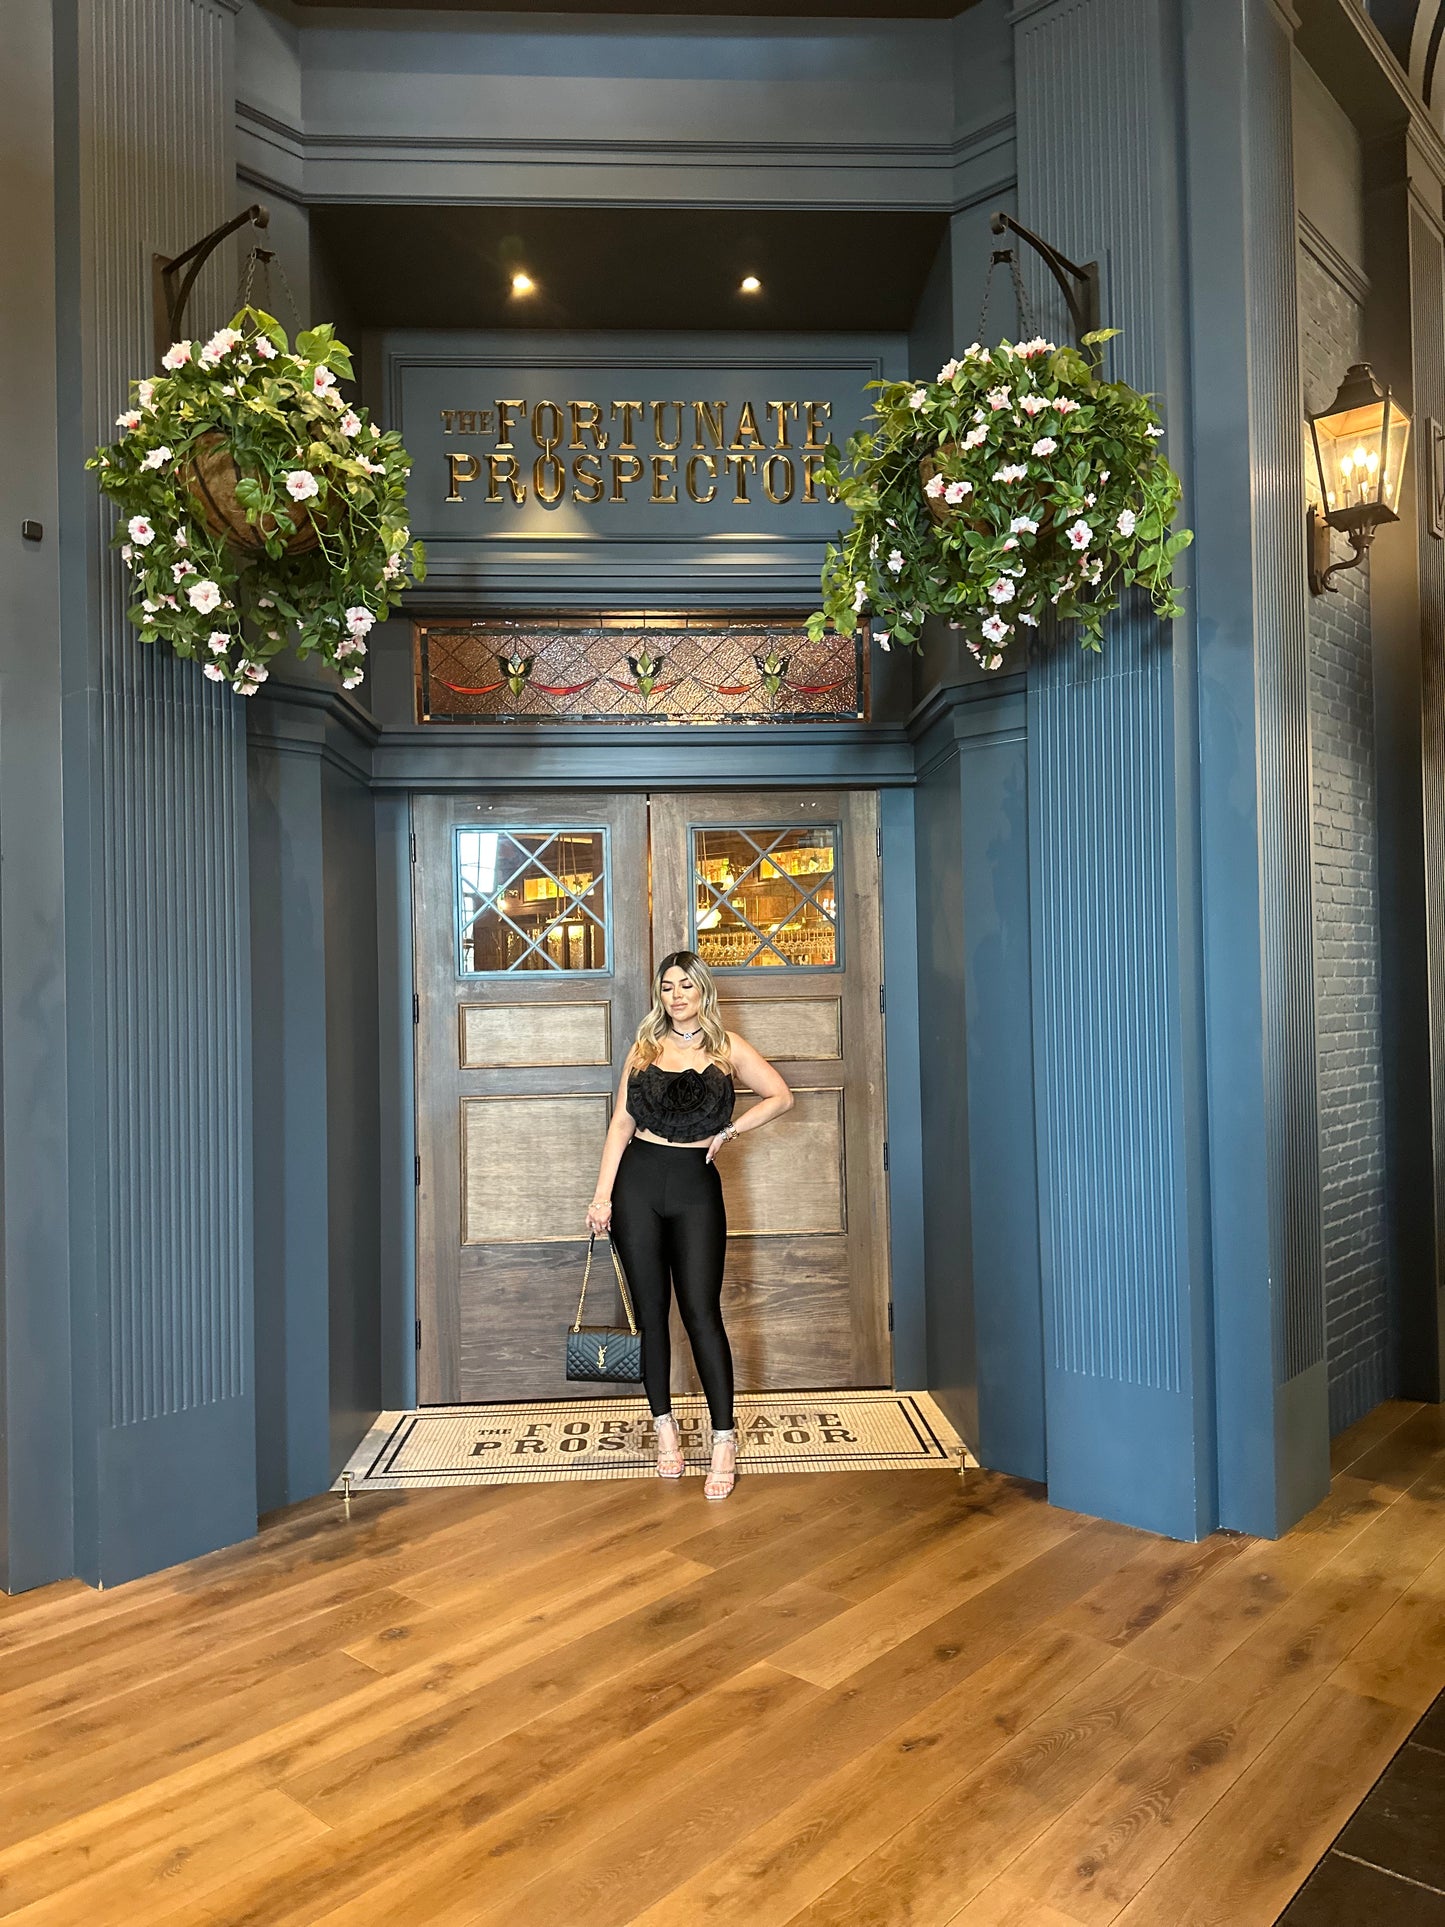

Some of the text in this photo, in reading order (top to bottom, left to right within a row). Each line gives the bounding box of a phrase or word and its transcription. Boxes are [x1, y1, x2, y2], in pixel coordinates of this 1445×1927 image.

[440, 399, 833, 451] THE FORTUNATE
[477, 1413, 843, 1438] THE FORTUATE
[468, 1429, 858, 1457] PROSPETOR
